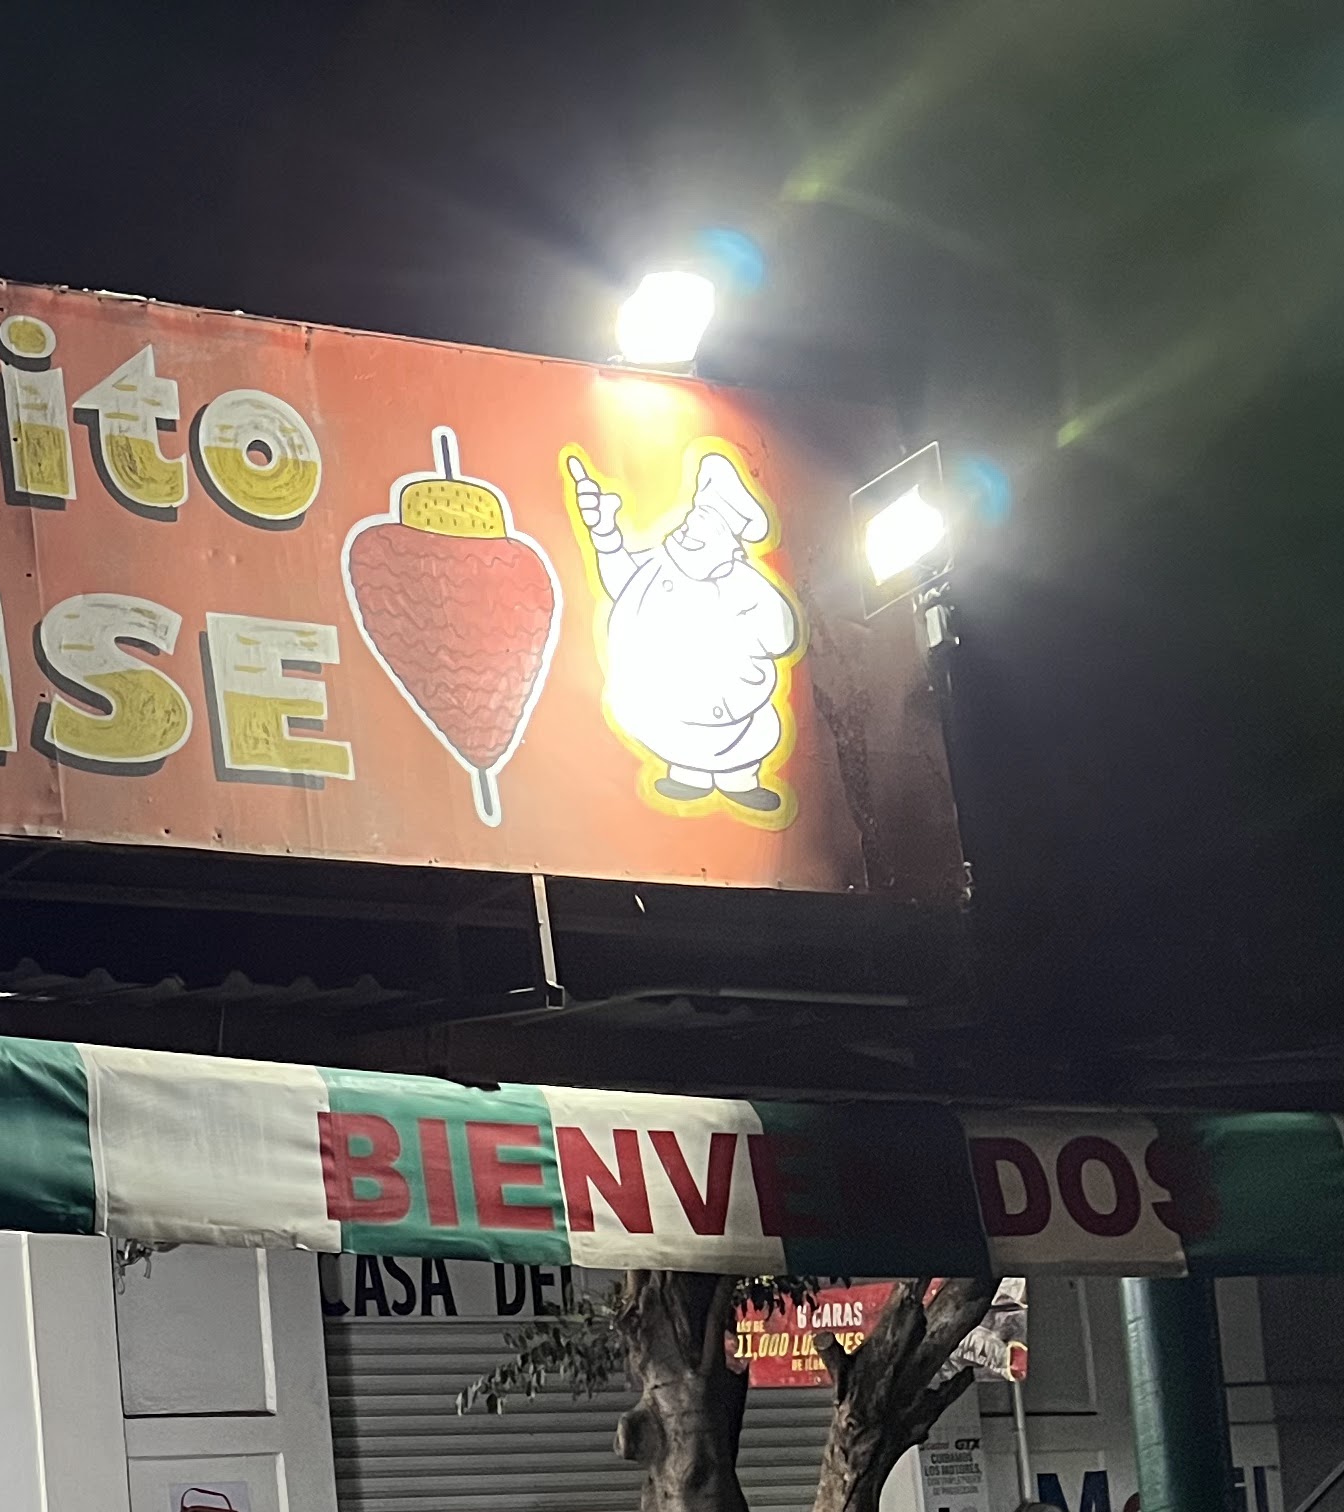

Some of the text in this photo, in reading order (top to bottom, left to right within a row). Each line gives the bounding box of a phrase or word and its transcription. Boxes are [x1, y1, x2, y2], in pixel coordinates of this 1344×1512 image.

[316, 1110, 1224, 1238] BIENVEDOS
[317, 1251, 459, 1317] CASA
[812, 1301, 864, 1328] CARAS
[733, 1332, 790, 1361] 11,000
